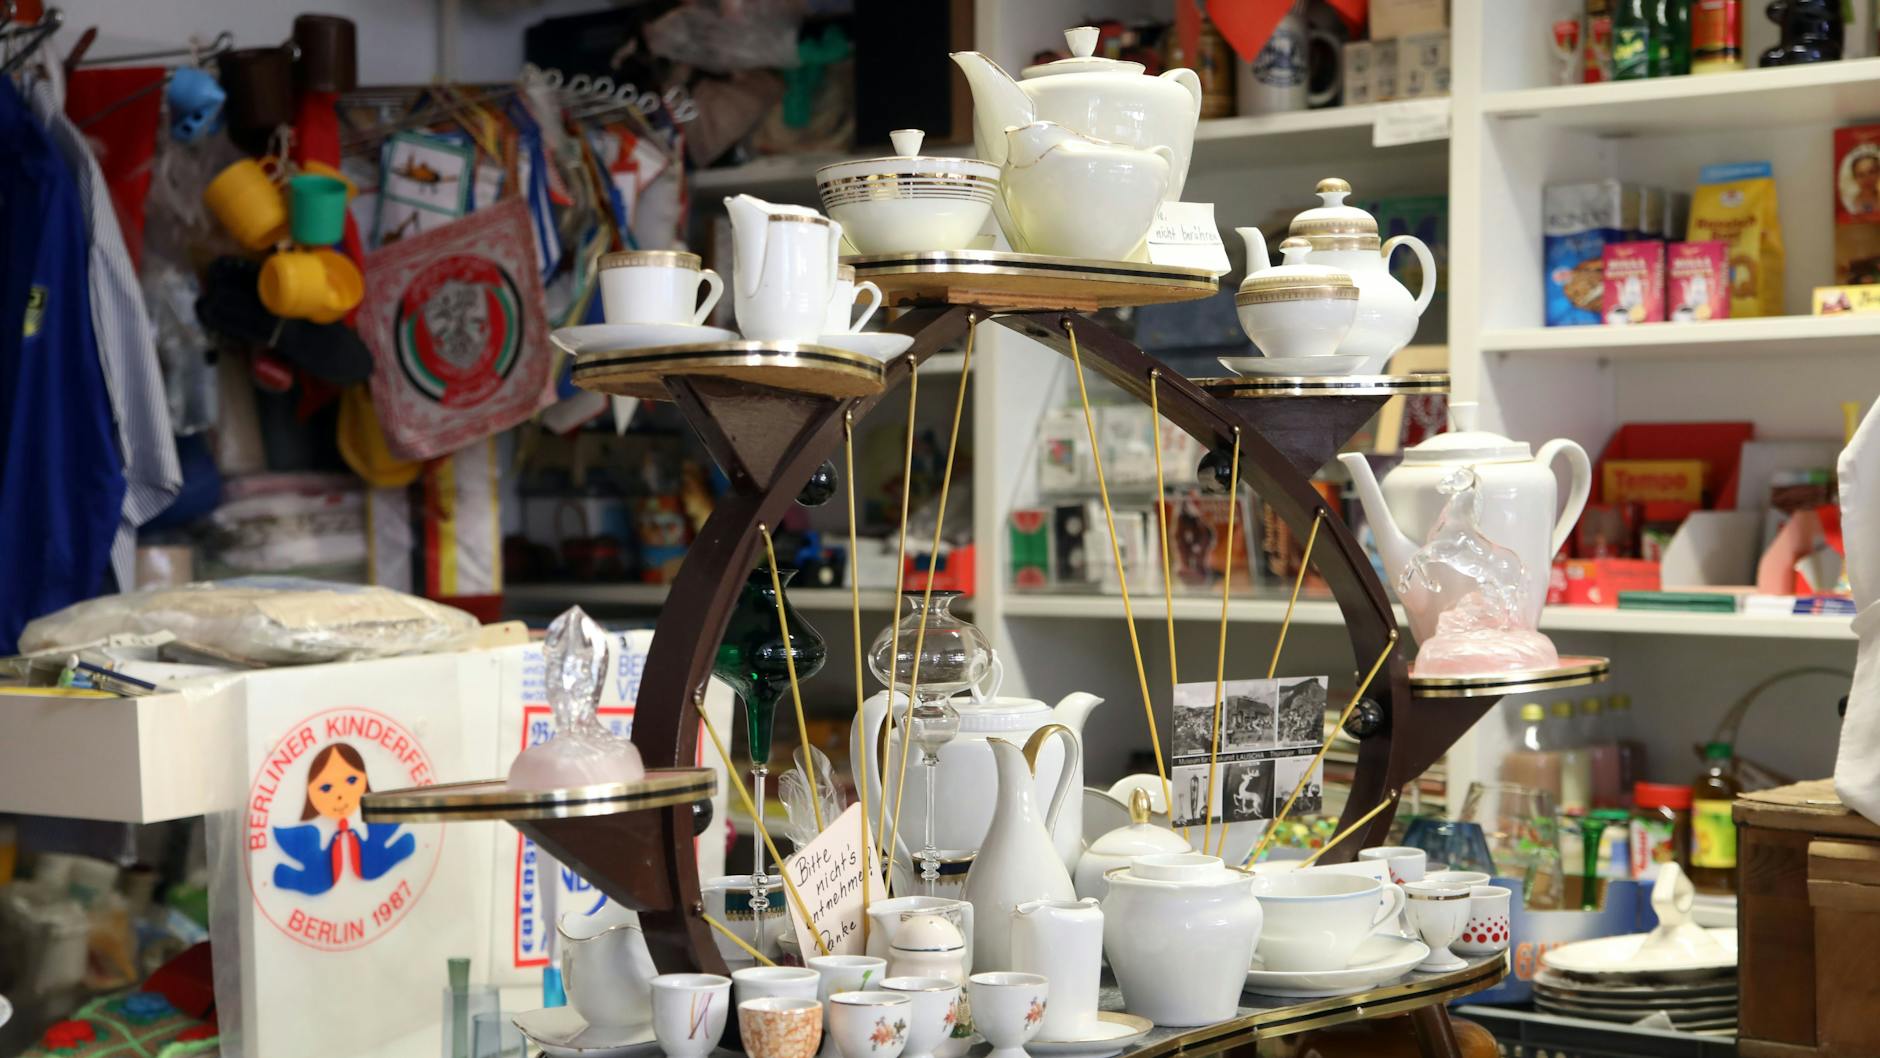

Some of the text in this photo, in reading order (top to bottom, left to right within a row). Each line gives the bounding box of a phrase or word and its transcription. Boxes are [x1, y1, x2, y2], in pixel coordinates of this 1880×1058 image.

[250, 727, 317, 851] BERLINER
[795, 848, 832, 888] Bitte
[816, 844, 857, 896] nicht's
[287, 879, 412, 944] BERLIN 1987
